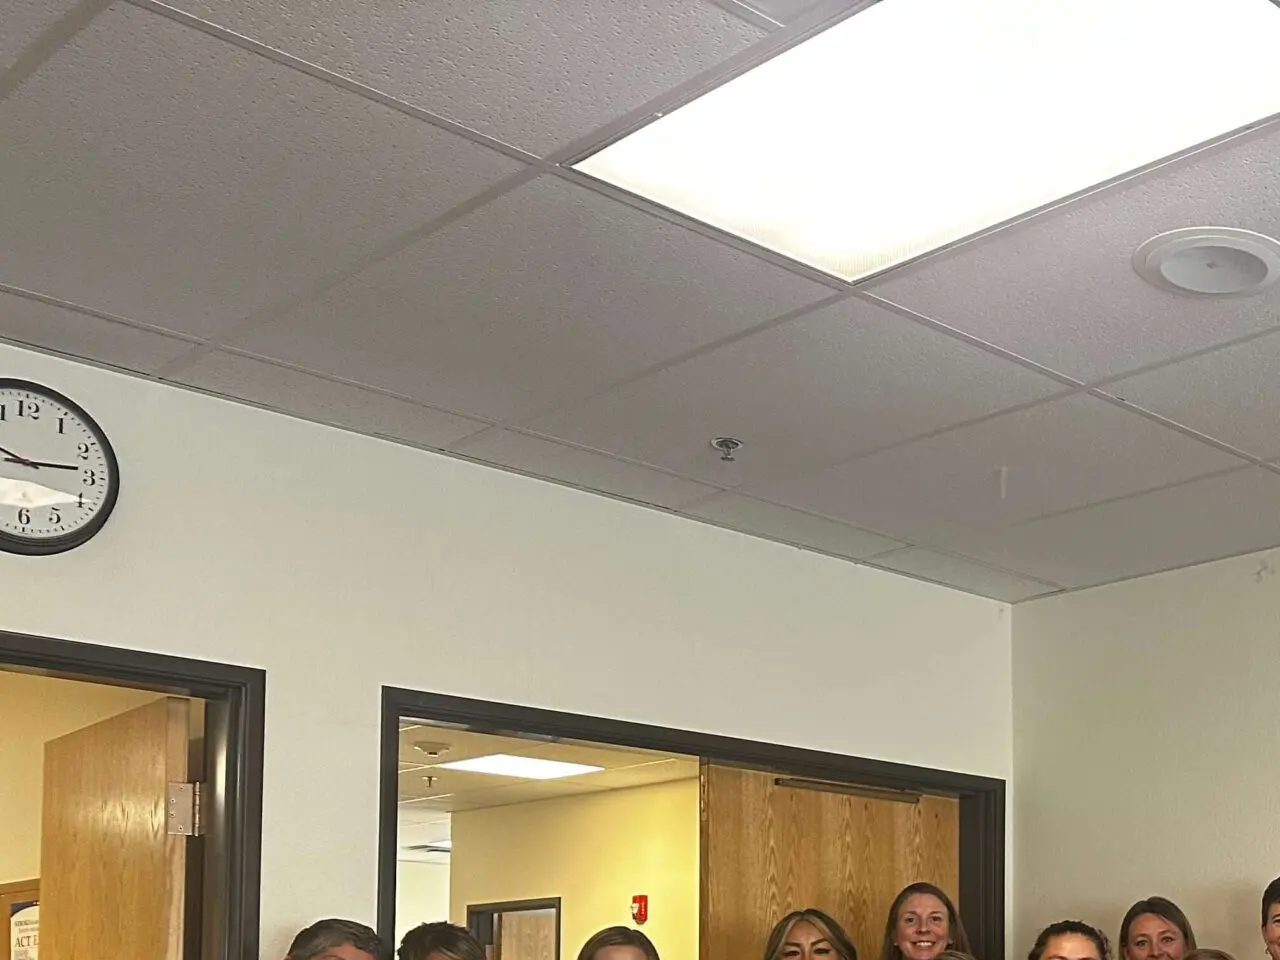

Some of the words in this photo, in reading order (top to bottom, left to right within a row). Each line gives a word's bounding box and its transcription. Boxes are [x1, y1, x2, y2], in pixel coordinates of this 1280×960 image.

[17, 400, 40, 420] 12
[57, 418, 65, 434] 1
[77, 443, 89, 460] 2
[83, 469, 96, 486] 3
[18, 508, 30, 525] 6
[49, 507, 61, 524] 5
